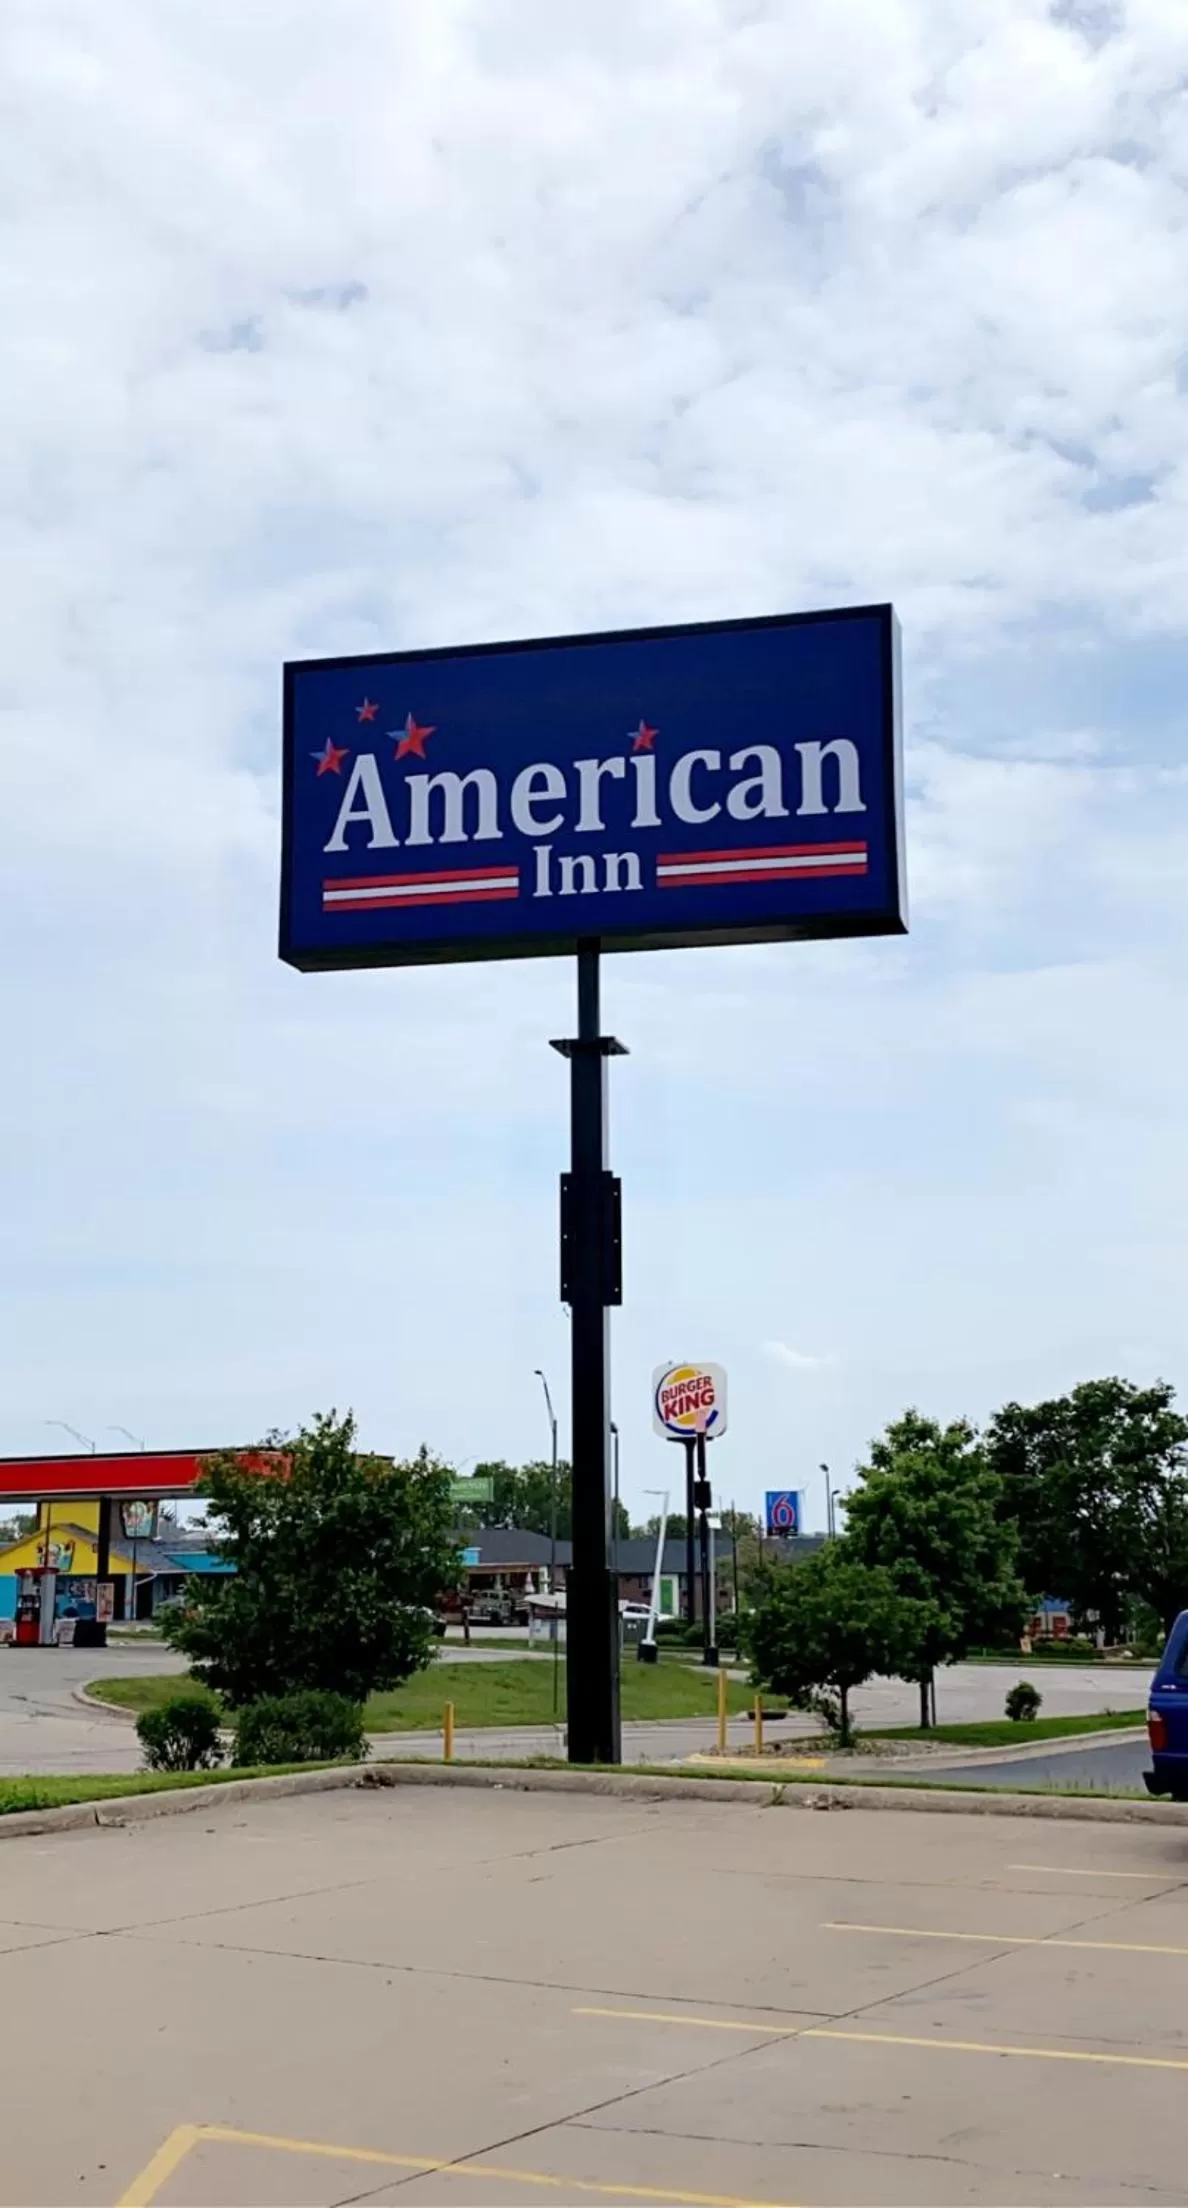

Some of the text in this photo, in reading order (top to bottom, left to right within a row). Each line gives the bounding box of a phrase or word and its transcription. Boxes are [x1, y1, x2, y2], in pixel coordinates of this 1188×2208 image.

[323, 736, 867, 852] American
[532, 845, 644, 897] Inn
[661, 1375, 712, 1404] BURGER
[664, 1388, 715, 1421] KING
[771, 1493, 796, 1527] 6
